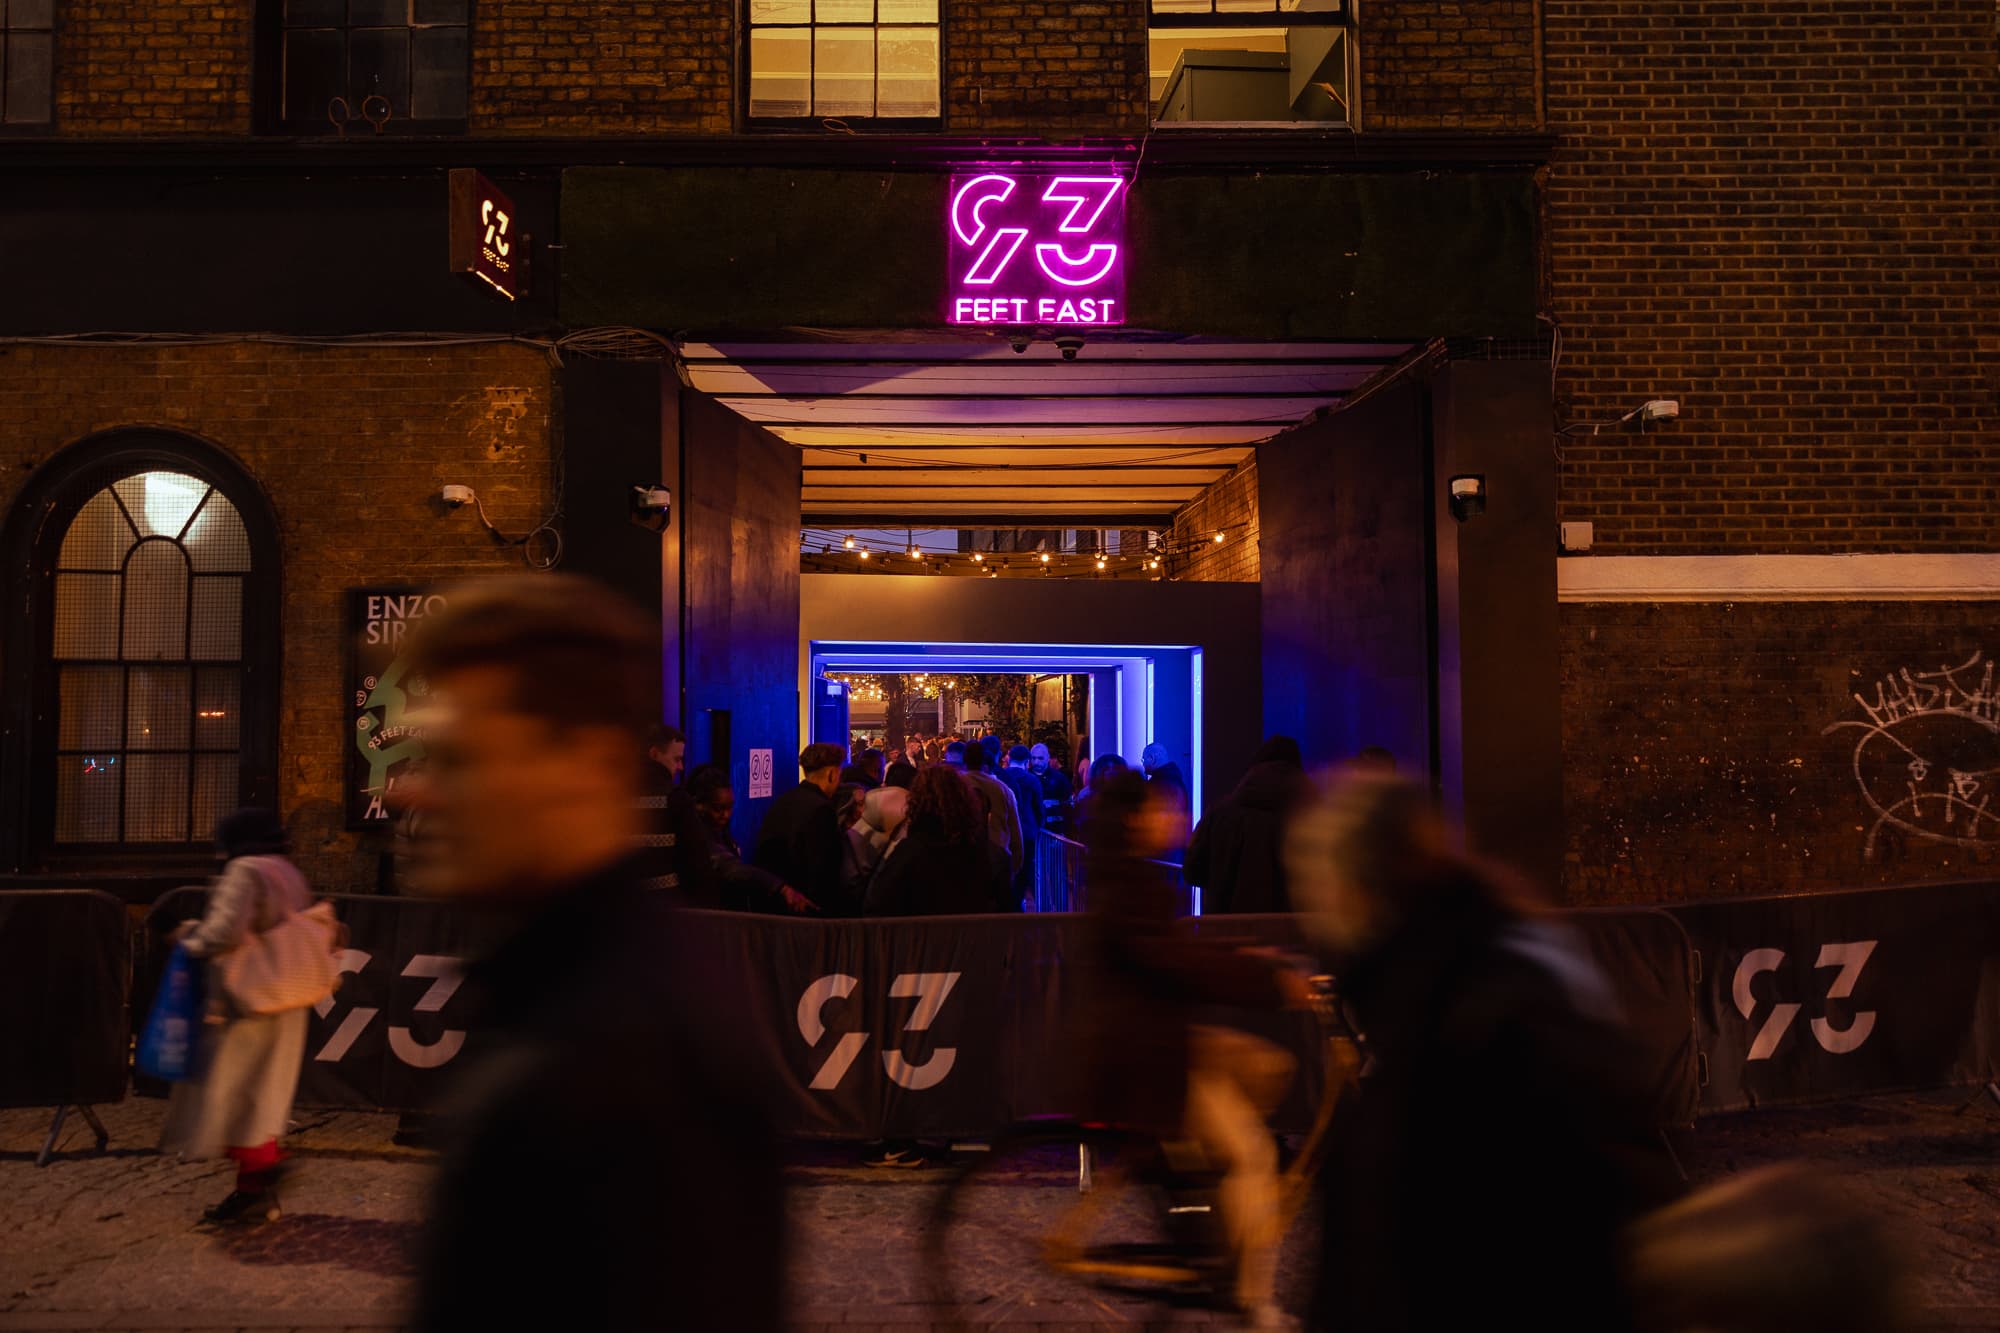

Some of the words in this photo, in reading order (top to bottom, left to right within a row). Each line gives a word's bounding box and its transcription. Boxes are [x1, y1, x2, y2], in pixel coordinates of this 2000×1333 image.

[952, 174, 1123, 286] 93
[955, 298, 1029, 322] FEET
[1038, 298, 1115, 322] EAST
[367, 594, 448, 620] ENZO
[367, 735, 382, 750] 93
[379, 725, 408, 742] FEET
[797, 971, 962, 1090] 93
[1732, 940, 1878, 1060] 93
